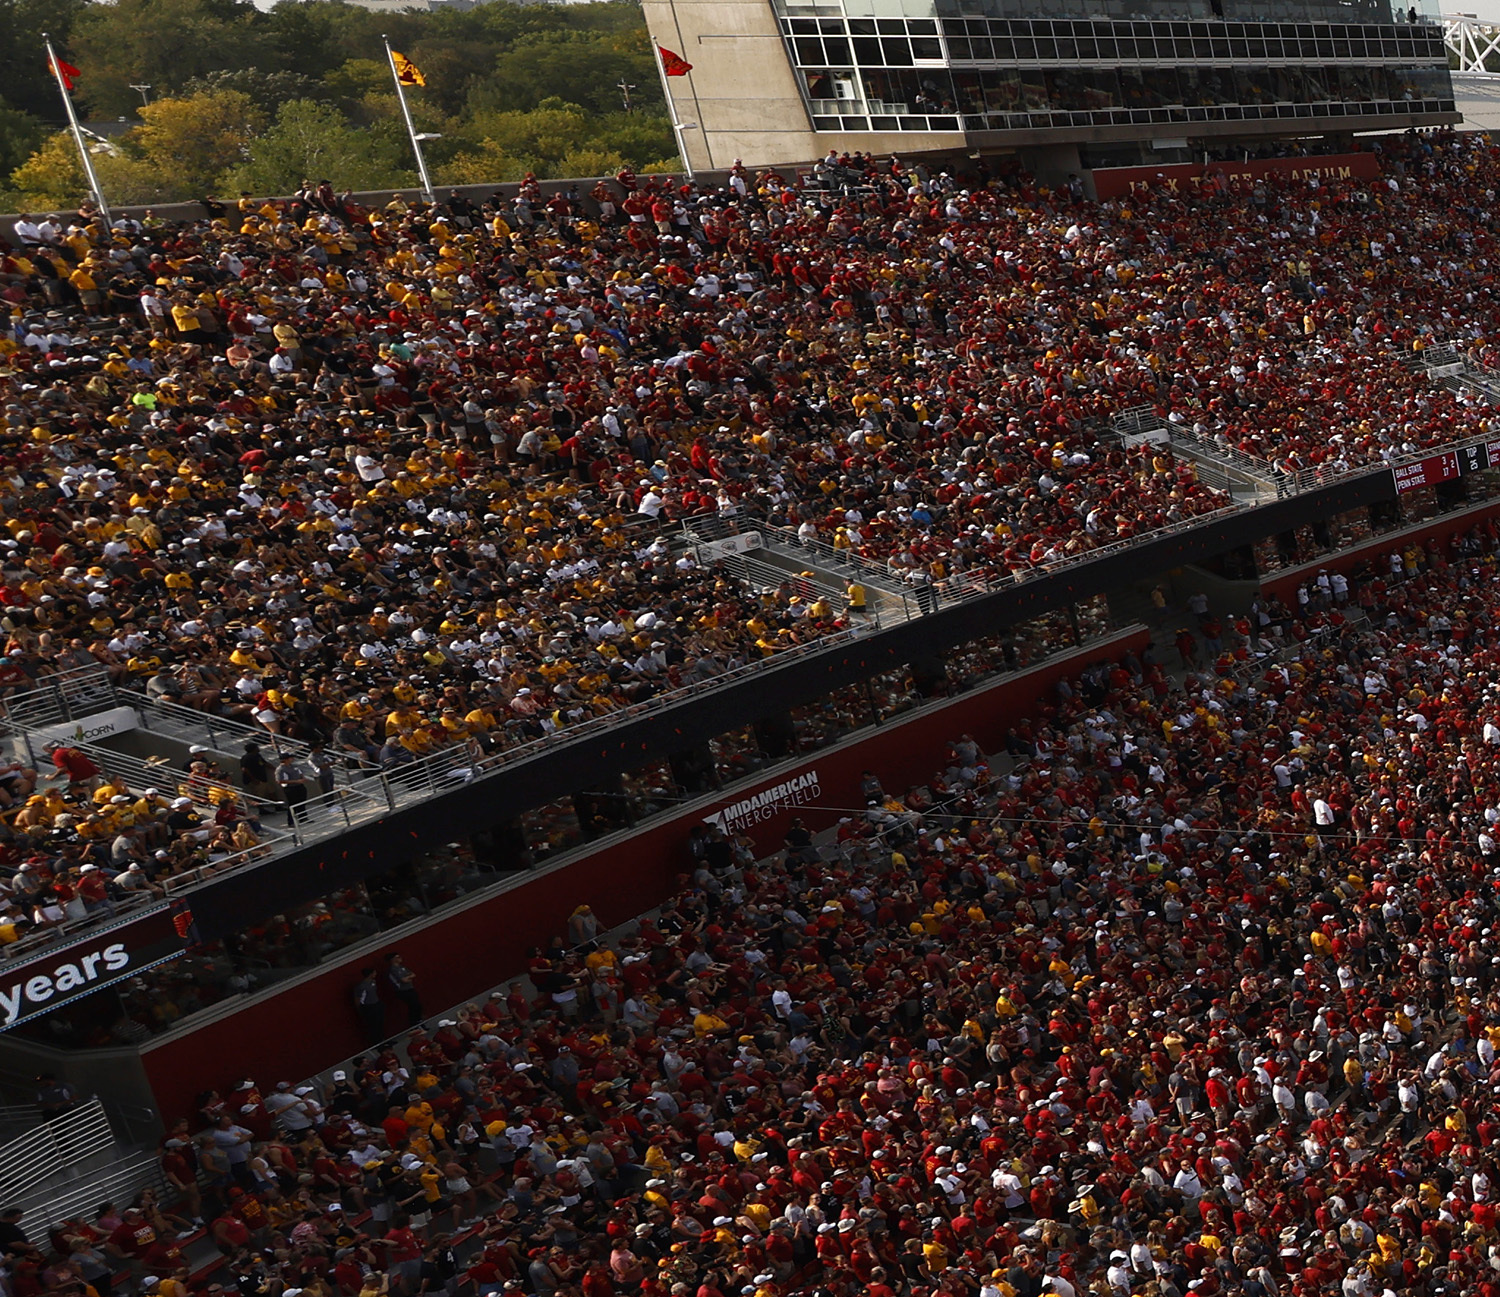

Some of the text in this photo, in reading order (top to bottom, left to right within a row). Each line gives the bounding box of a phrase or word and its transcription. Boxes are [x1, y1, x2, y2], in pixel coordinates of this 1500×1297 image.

[1465, 446, 1478, 458] TOP
[1395, 462, 1423, 479] BALL STATE
[1469, 460, 1478, 470] 25
[1397, 474, 1426, 489] PENN STATE
[723, 770, 818, 822] MIDAMERICAN
[727, 784, 821, 836] ENERGY FIELD
[0, 942, 130, 1025] years
